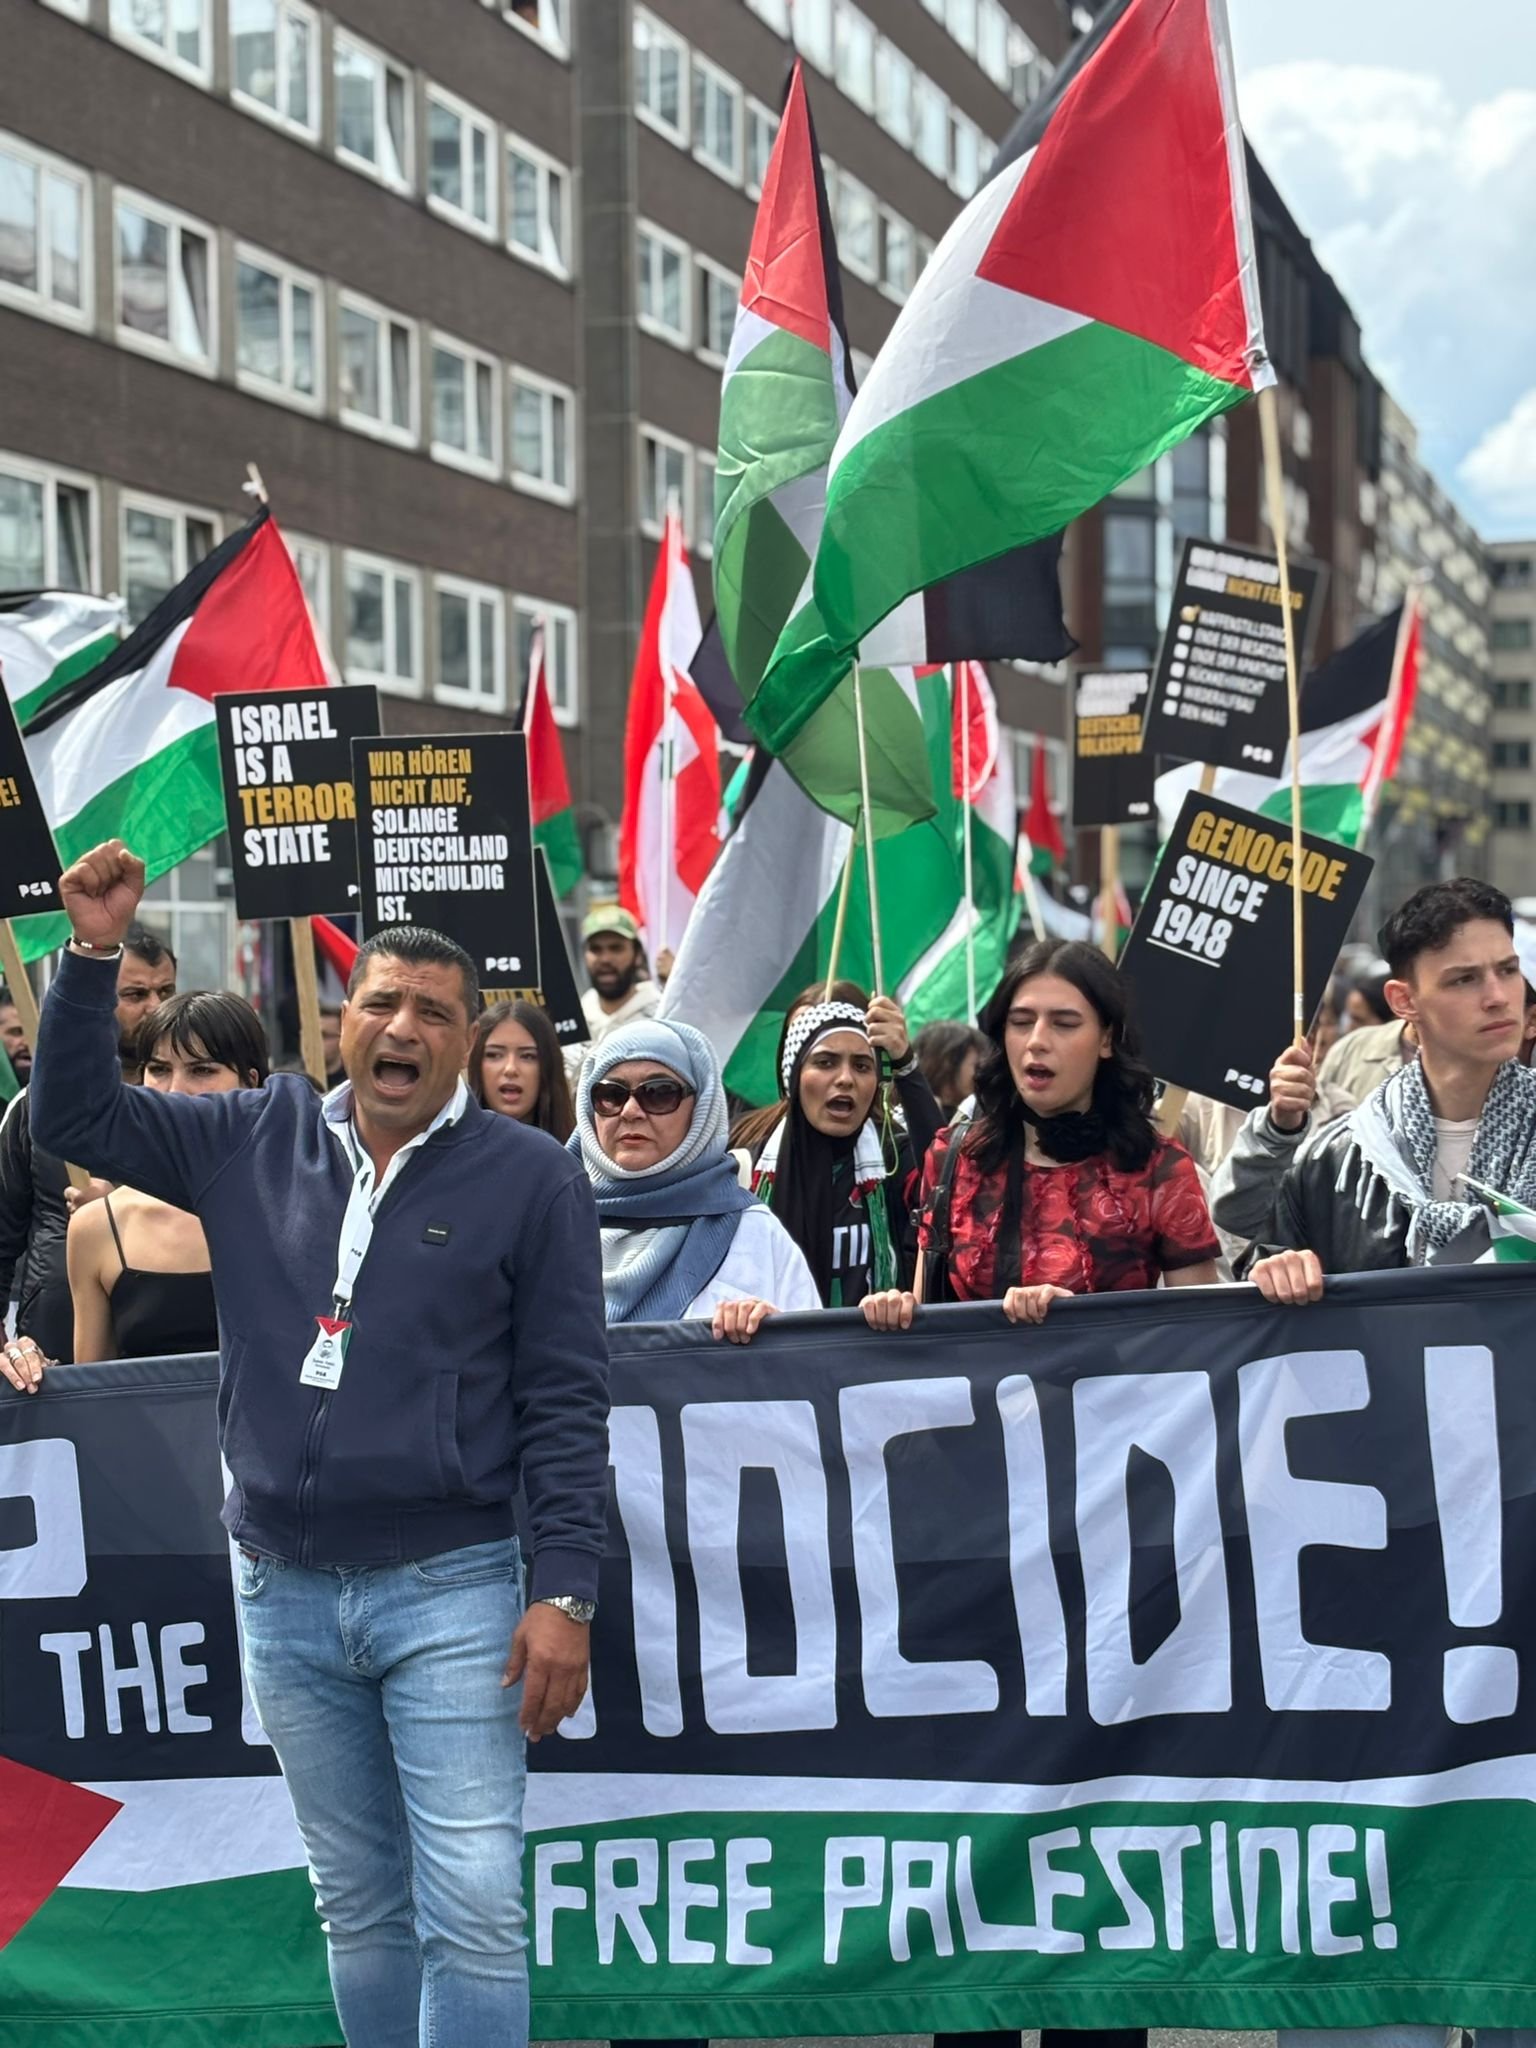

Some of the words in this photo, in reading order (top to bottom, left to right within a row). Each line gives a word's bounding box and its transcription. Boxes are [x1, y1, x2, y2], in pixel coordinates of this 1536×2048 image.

[230, 701, 337, 745] ISRAEL
[234, 746, 266, 786] IS
[272, 745, 293, 784] A
[368, 750, 405, 776] WIR
[408, 744, 472, 775] HÖREN
[238, 781, 357, 826] TERROR
[370, 780, 426, 806] NICHT
[431, 778, 472, 806] AUF,
[372, 807, 458, 835] SOLANGE
[244, 824, 331, 867] STATE
[373, 835, 508, 864] DEUTSCHLAND
[375, 864, 504, 893] MITSCHULDIG
[1169, 855, 1268, 923] SINCE
[376, 896, 412, 922] IST.
[1151, 899, 1232, 959] 1948
[40, 1622, 213, 1739] THE
[534, 1838, 773, 1966] FREE
[823, 1821, 1397, 1966] PALESTINE!
